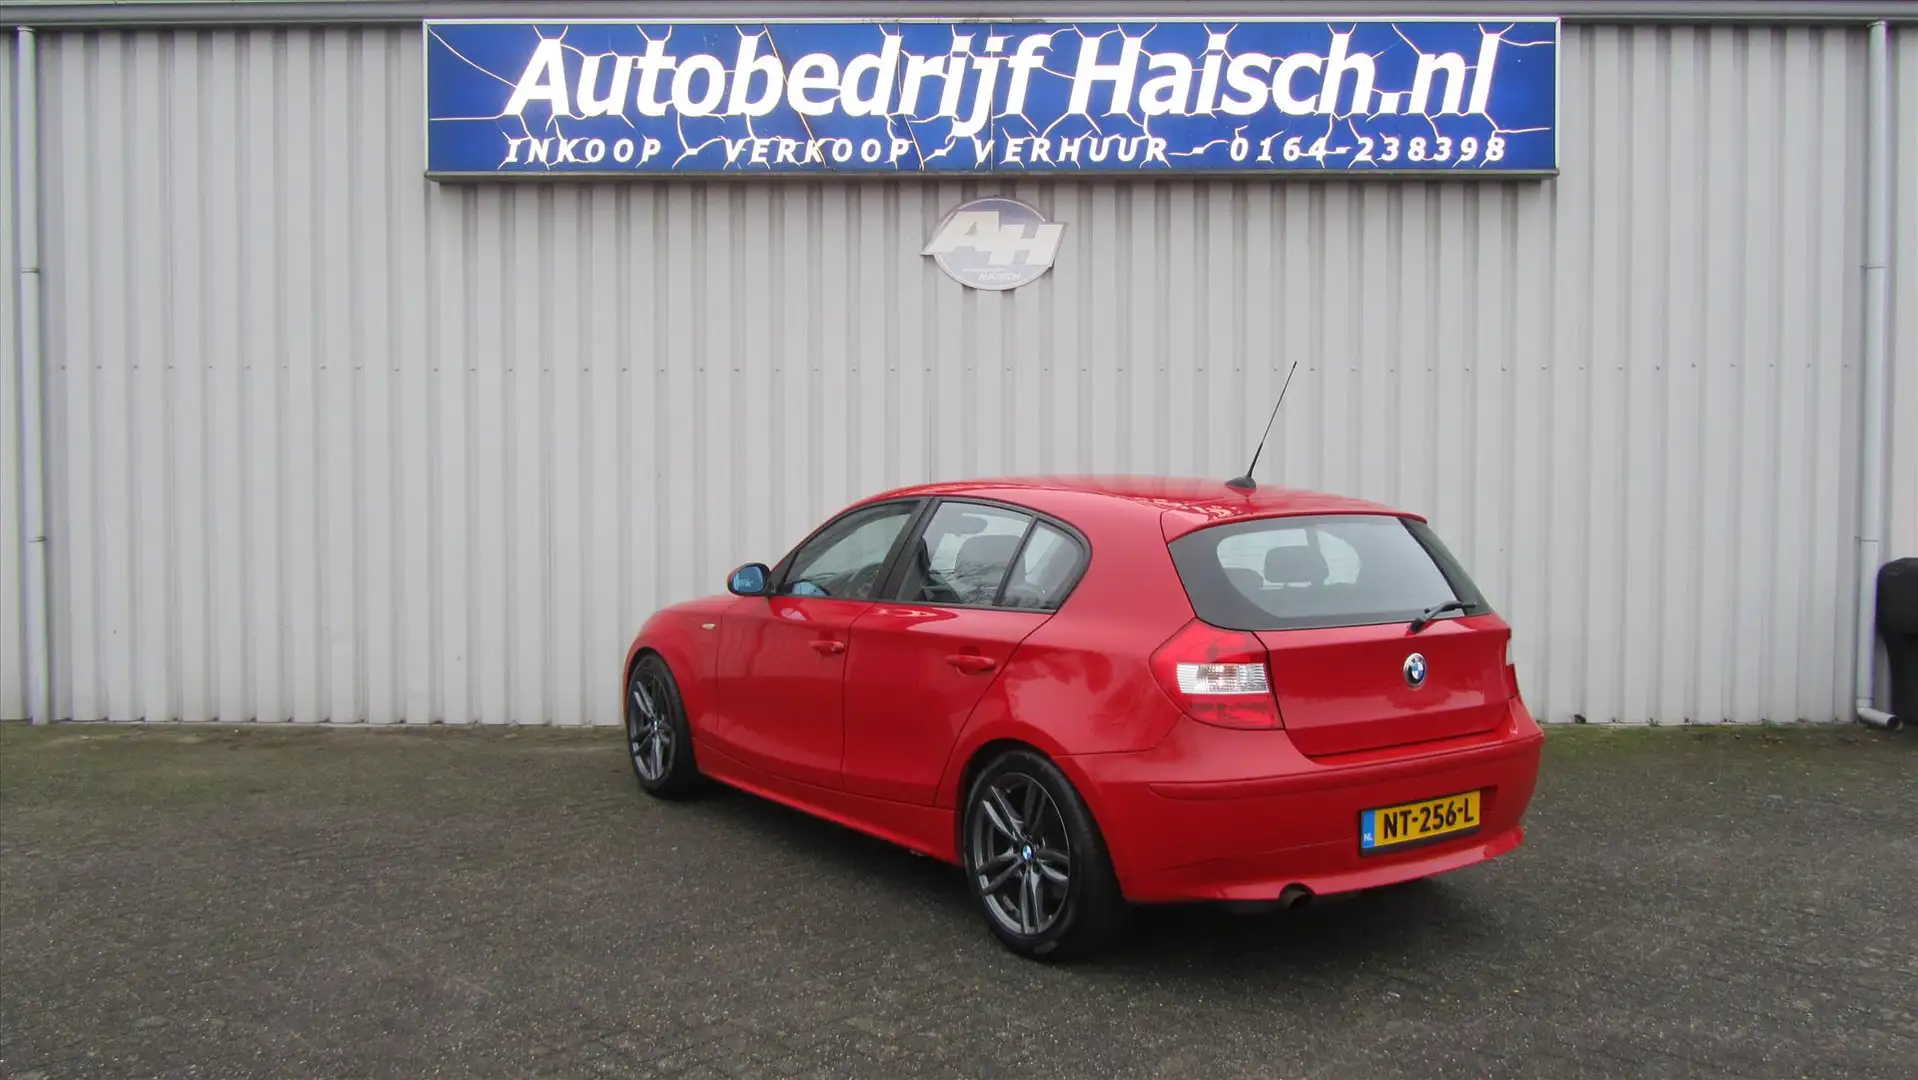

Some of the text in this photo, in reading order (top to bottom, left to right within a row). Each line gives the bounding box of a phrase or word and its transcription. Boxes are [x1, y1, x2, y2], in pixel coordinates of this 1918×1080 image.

[503, 32, 1502, 137] Autobedrijf Haisch.nl
[505, 138, 662, 163] INKOOP
[724, 138, 912, 163] VERKOOP
[974, 137, 1169, 162] VERHUUR
[1230, 136, 1506, 162] 0164-238398
[1383, 797, 1475, 840] NT-256-L
[1362, 832, 1374, 842] NL
